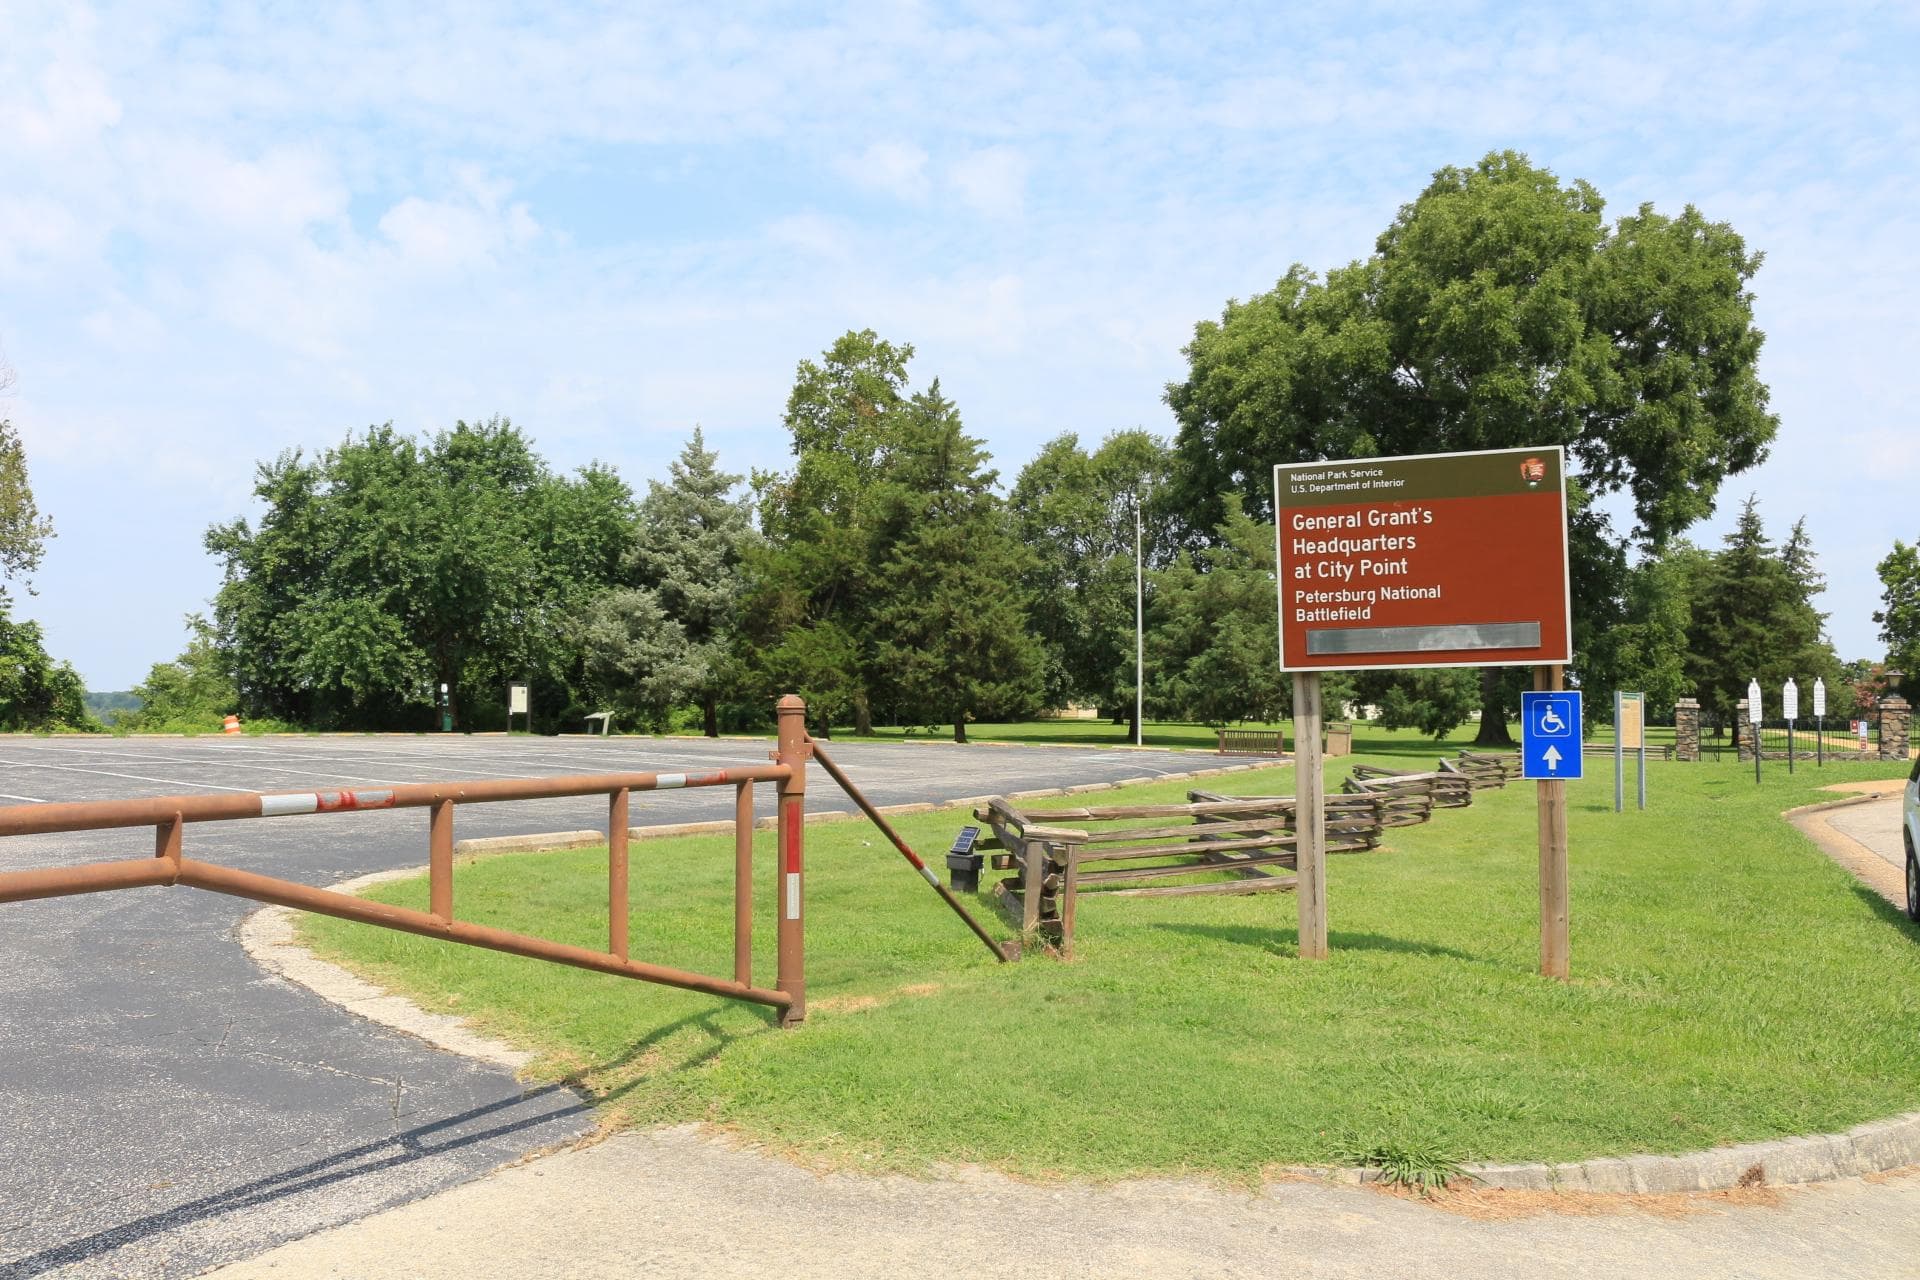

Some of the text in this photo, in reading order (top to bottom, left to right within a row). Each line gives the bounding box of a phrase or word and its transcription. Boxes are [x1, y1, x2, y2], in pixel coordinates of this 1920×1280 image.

[1290, 468, 1384, 482] National Park Service
[1290, 478, 1405, 494] U.S. Department of Interior
[1292, 507, 1433, 531] General Grant's
[1293, 534, 1416, 557] Headquarters
[1294, 557, 1408, 582] at City Point
[1295, 584, 1441, 605] Petersburg National
[1296, 606, 1371, 622] Battlefield
